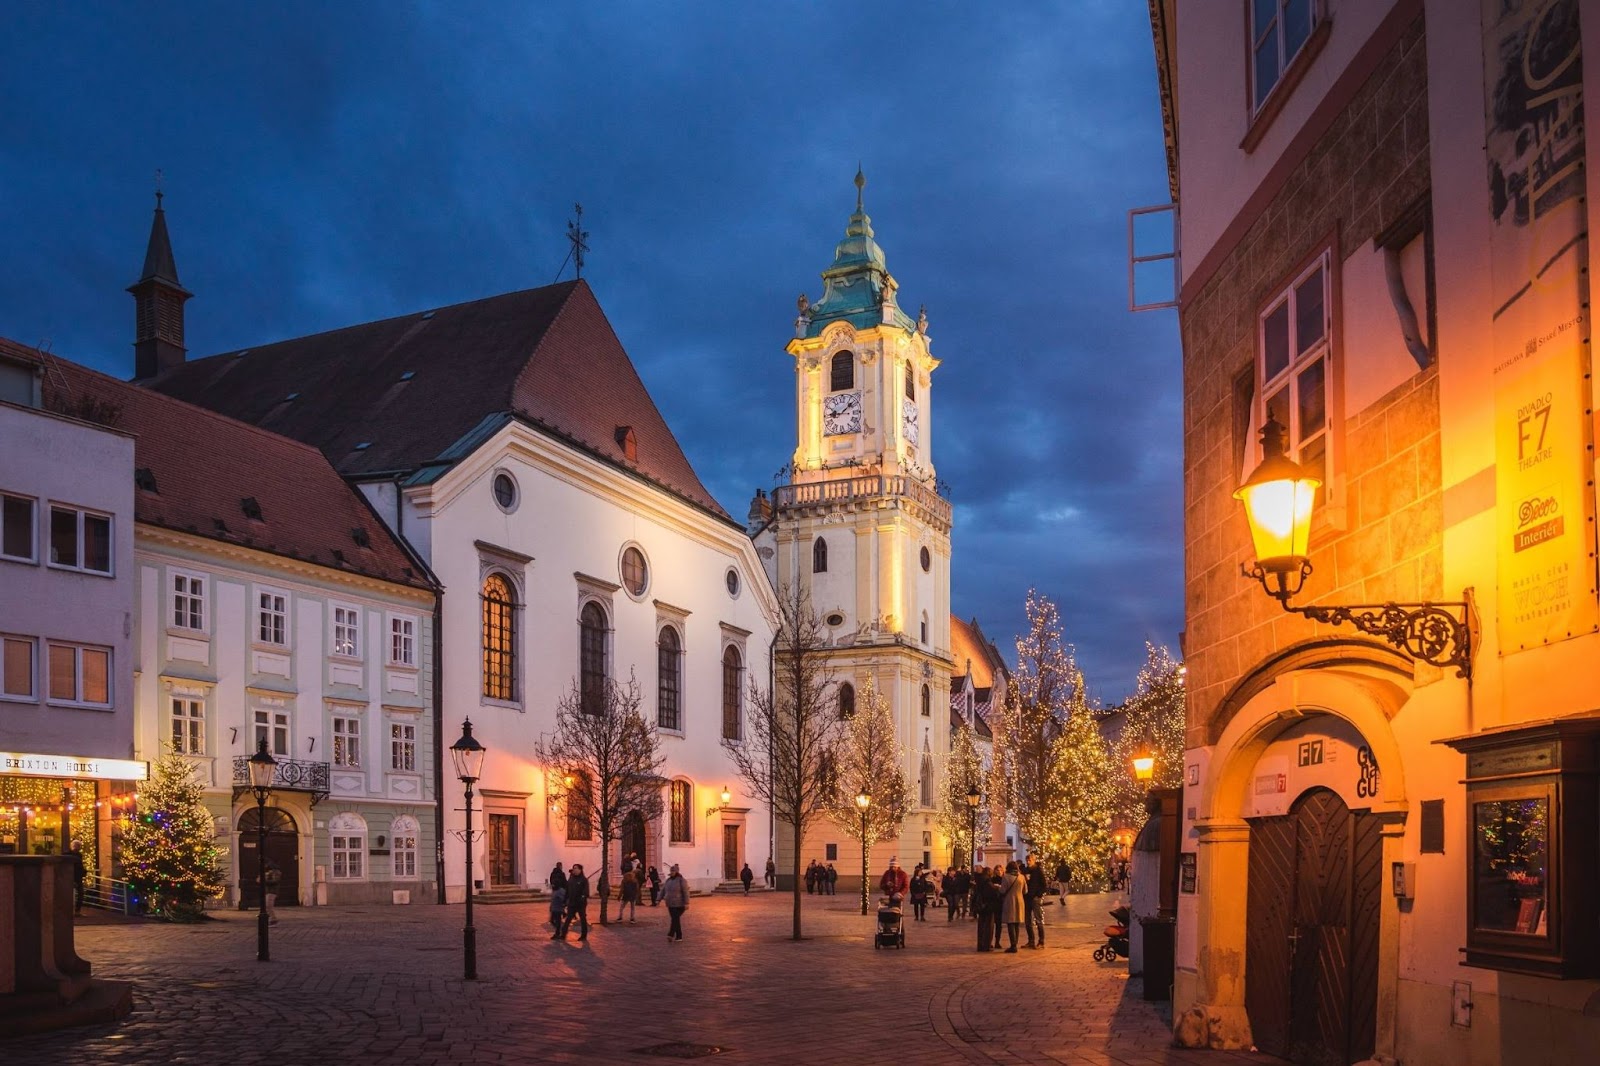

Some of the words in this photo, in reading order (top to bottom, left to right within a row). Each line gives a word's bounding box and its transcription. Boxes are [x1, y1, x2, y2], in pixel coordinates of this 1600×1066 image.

[1517, 391, 1553, 420] DIVADLO
[1517, 404, 1552, 461] F7
[1518, 446, 1553, 473] THEATRE
[5, 758, 58, 771] BRIXTON
[66, 762, 99, 773] HOUSE
[1300, 742, 1322, 766] F7
[1357, 778, 1377, 798] GU
